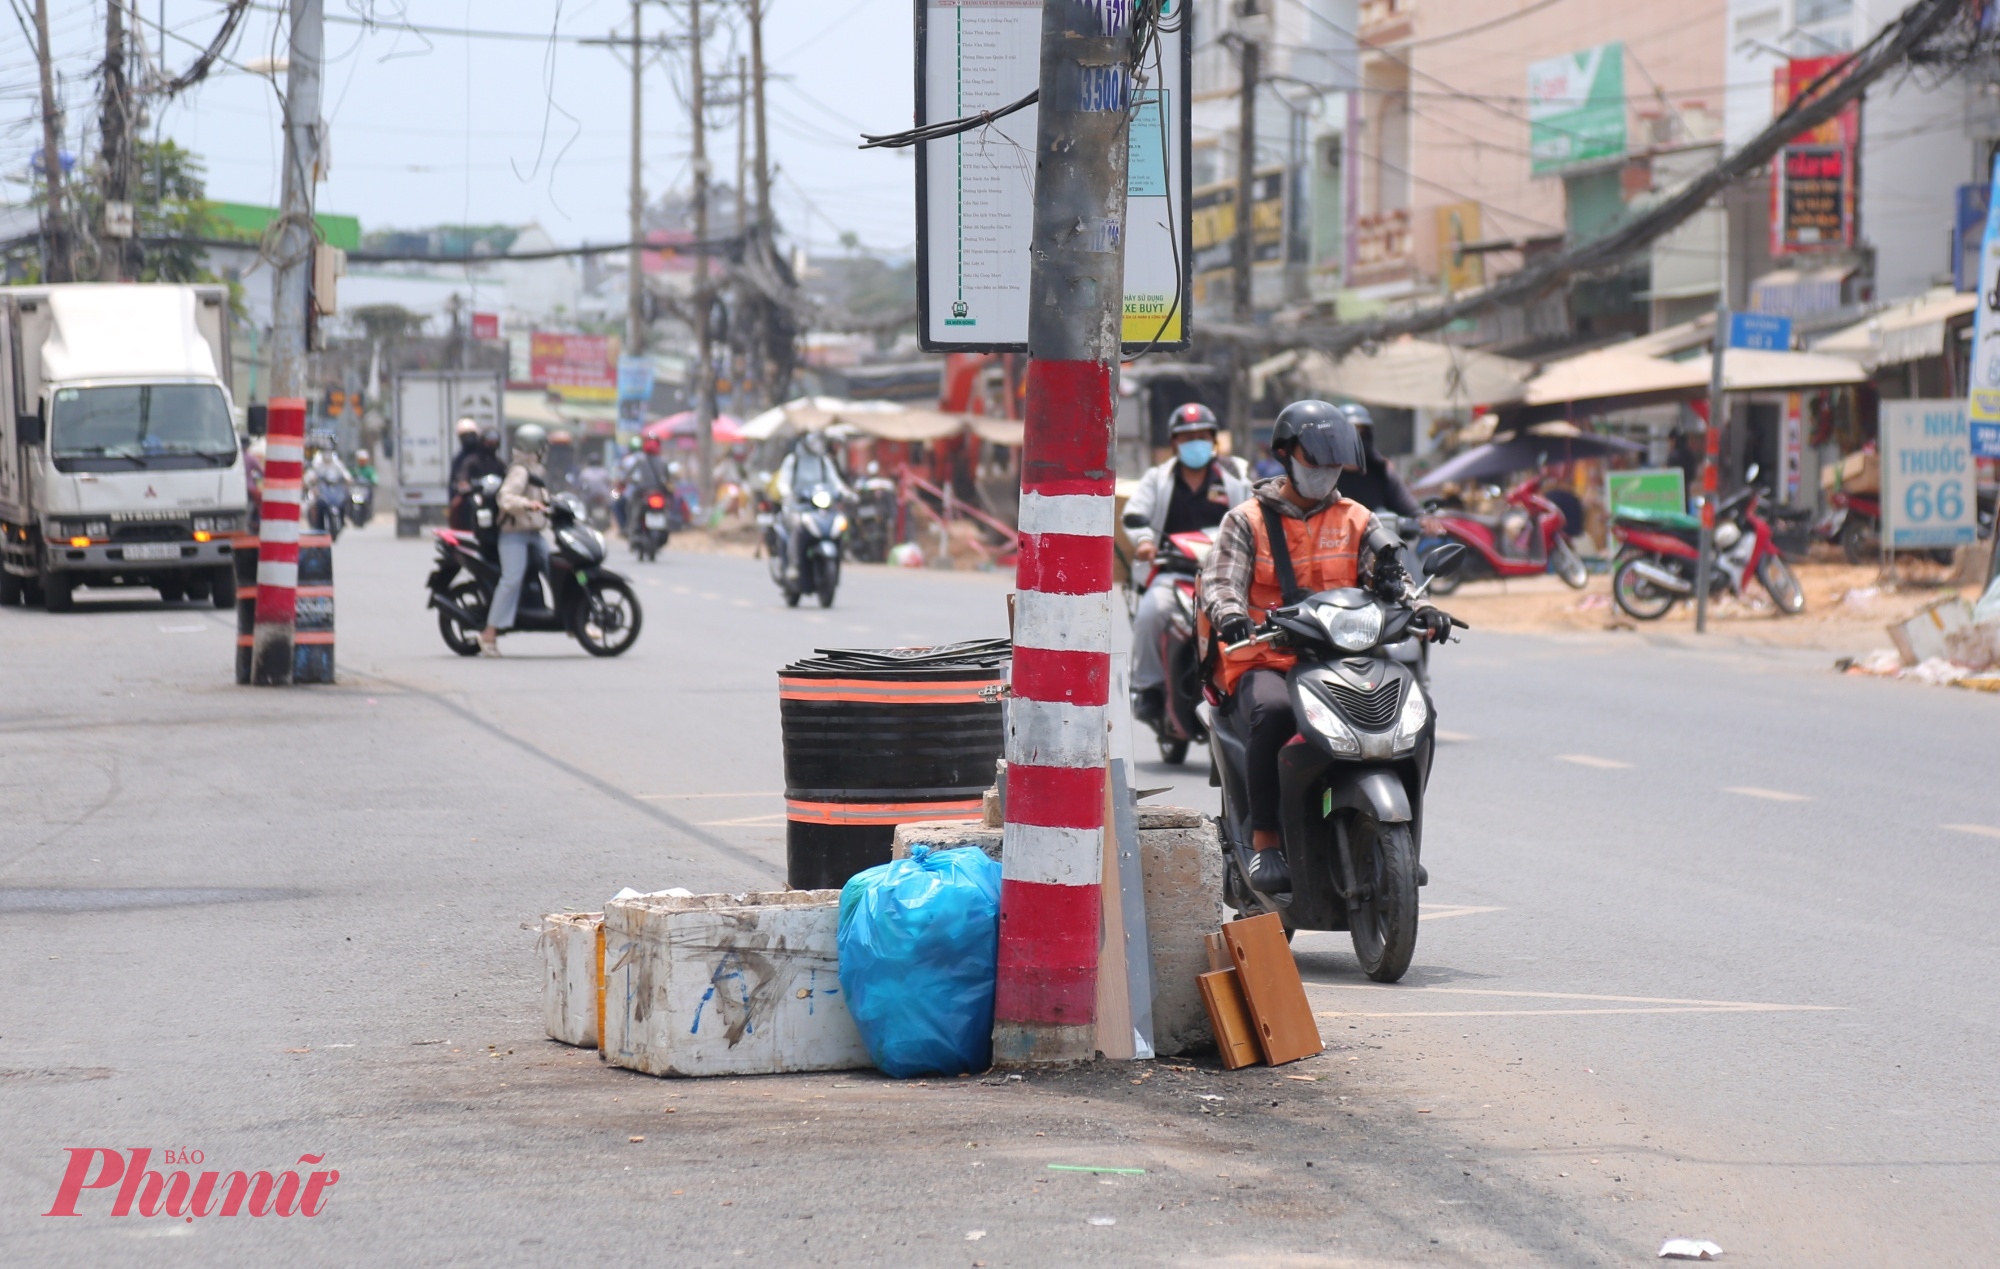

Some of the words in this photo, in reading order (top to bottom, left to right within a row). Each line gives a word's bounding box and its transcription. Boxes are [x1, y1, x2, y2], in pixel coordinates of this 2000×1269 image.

[1125, 304, 1136, 313] XE
[1140, 302, 1164, 313] BUÝT
[1147, 294, 1164, 302] DỤNG
[1925, 407, 1968, 437] NHÀ
[1900, 443, 1966, 474] THUỐC
[1904, 480, 1964, 523] 66
